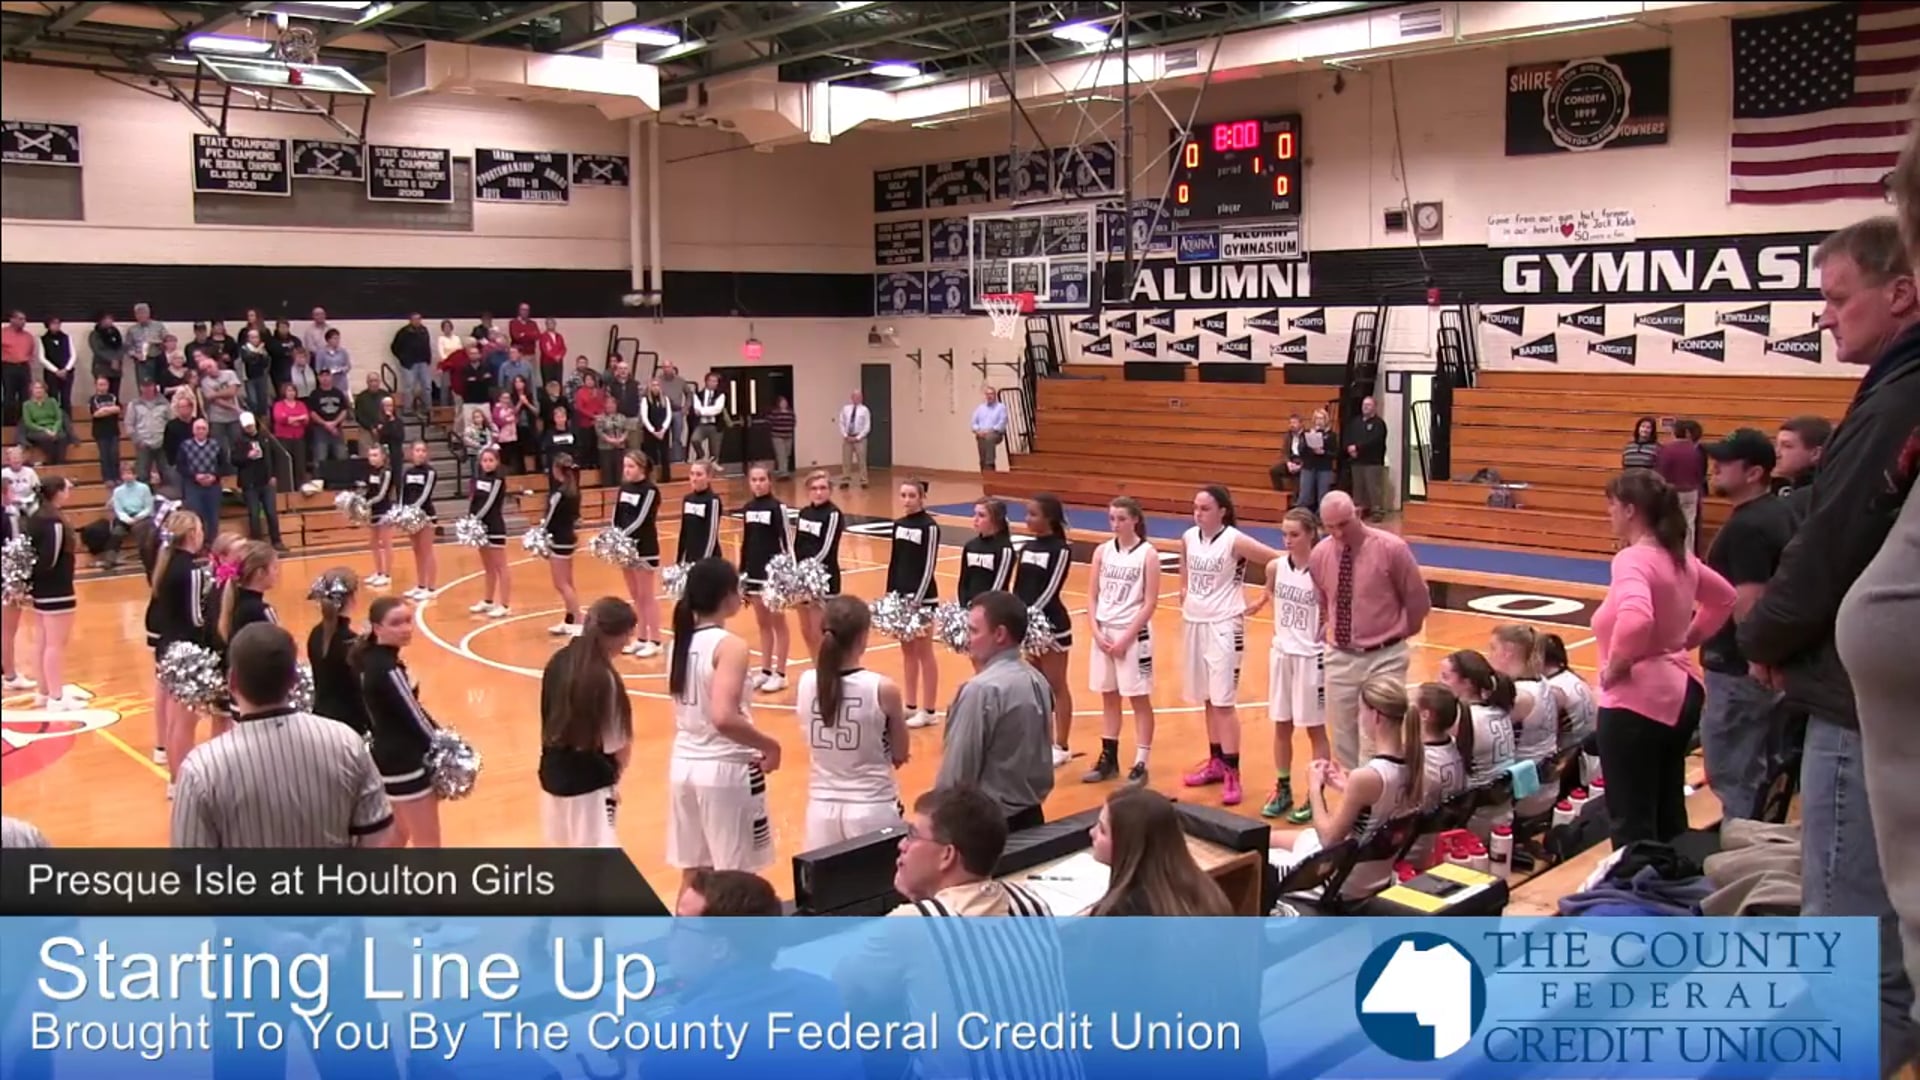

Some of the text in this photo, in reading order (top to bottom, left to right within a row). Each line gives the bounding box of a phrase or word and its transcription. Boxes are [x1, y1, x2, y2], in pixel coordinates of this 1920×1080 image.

[1510, 71, 1553, 92] SHIRE
[1564, 94, 1607, 105] CONDITA
[199, 136, 281, 151] STATE CHAMPIONS
[1214, 120, 1259, 152] 8:00
[1278, 132, 1292, 159] 0
[226, 149, 276, 161] CHAMPIONS
[1186, 143, 1199, 168] 0
[1178, 184, 1189, 203] 0
[1277, 175, 1288, 196] 0
[1224, 241, 1298, 257] GYMNASIUM
[1131, 245, 1822, 301] ALUMNI GYMNASI
[1519, 345, 1555, 356] BARNES
[1677, 339, 1724, 350] CONDON
[1772, 340, 1820, 352] LONDON
[811, 697, 863, 751] 25
